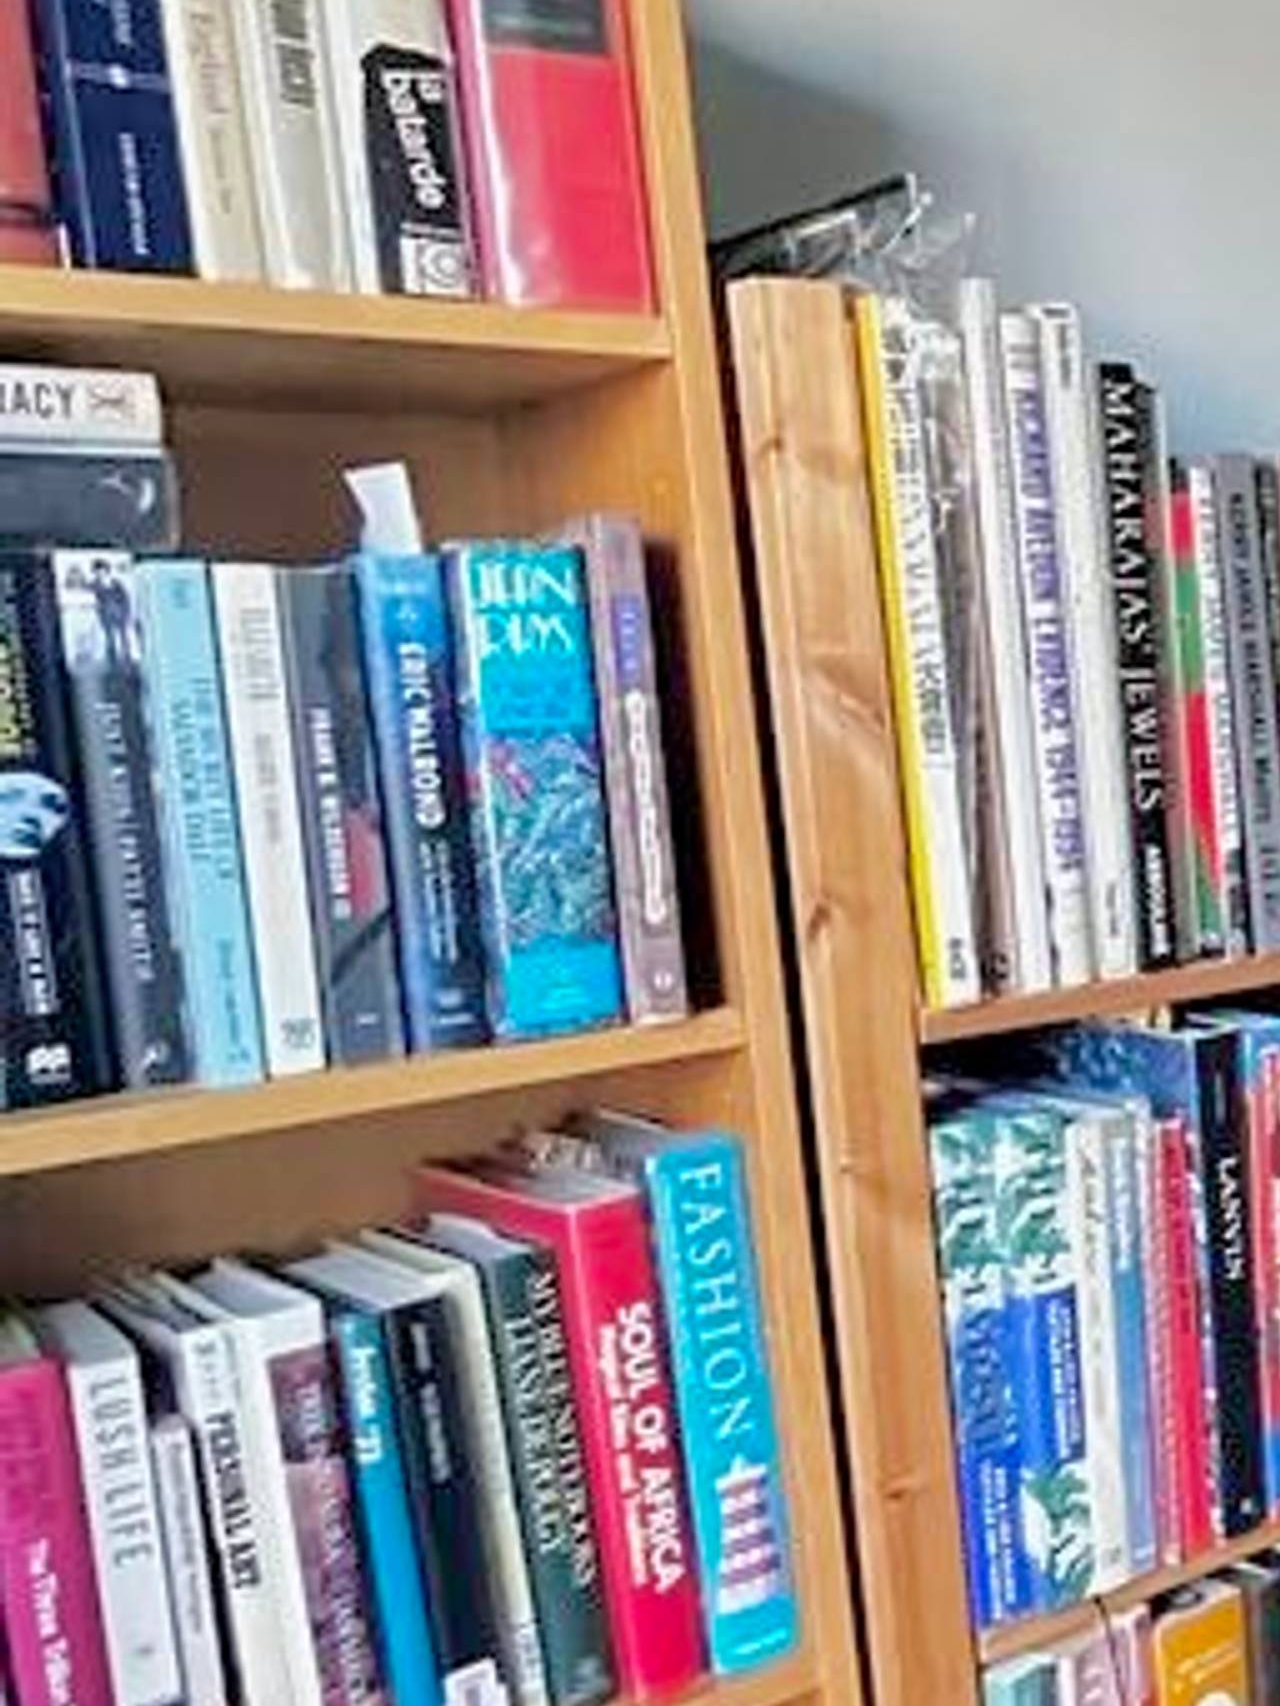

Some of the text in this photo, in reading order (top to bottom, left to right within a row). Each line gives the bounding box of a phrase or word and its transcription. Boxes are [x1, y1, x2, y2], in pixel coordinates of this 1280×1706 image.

[1013, 386, 1056, 499] RICHARD
[1020, 507, 1065, 605] AVEDON
[1227, 491, 1254, 564] KERRY
[1234, 566, 1261, 633] JAMES
[398, 642, 431, 700] ERIC
[1031, 615, 1072, 736] EVIDENCE
[1241, 639, 1272, 752] MARSHALL
[310, 706, 337, 765] FRANK
[404, 706, 448, 829] WALROND
[1120, 666, 1167, 811] JEWELS
[118, 836, 156, 980] PATTI SMITH
[1217, 1154, 1247, 1281] LANVIN
[677, 1160, 756, 1442] FASHION
[88, 1373, 153, 1567] LUSH LIFE
[503, 1315, 567, 1556] LIANE DE POUGY
[531, 1270, 559, 1320] MY
[552, 1395, 596, 1588] NOTEBOOKS
[616, 1301, 686, 1593] SOUL OF AFRICA
[26, 1537, 51, 1578] The
[203, 1410, 260, 1591] PERSONAL ART
[30, 1574, 64, 1638] Three
